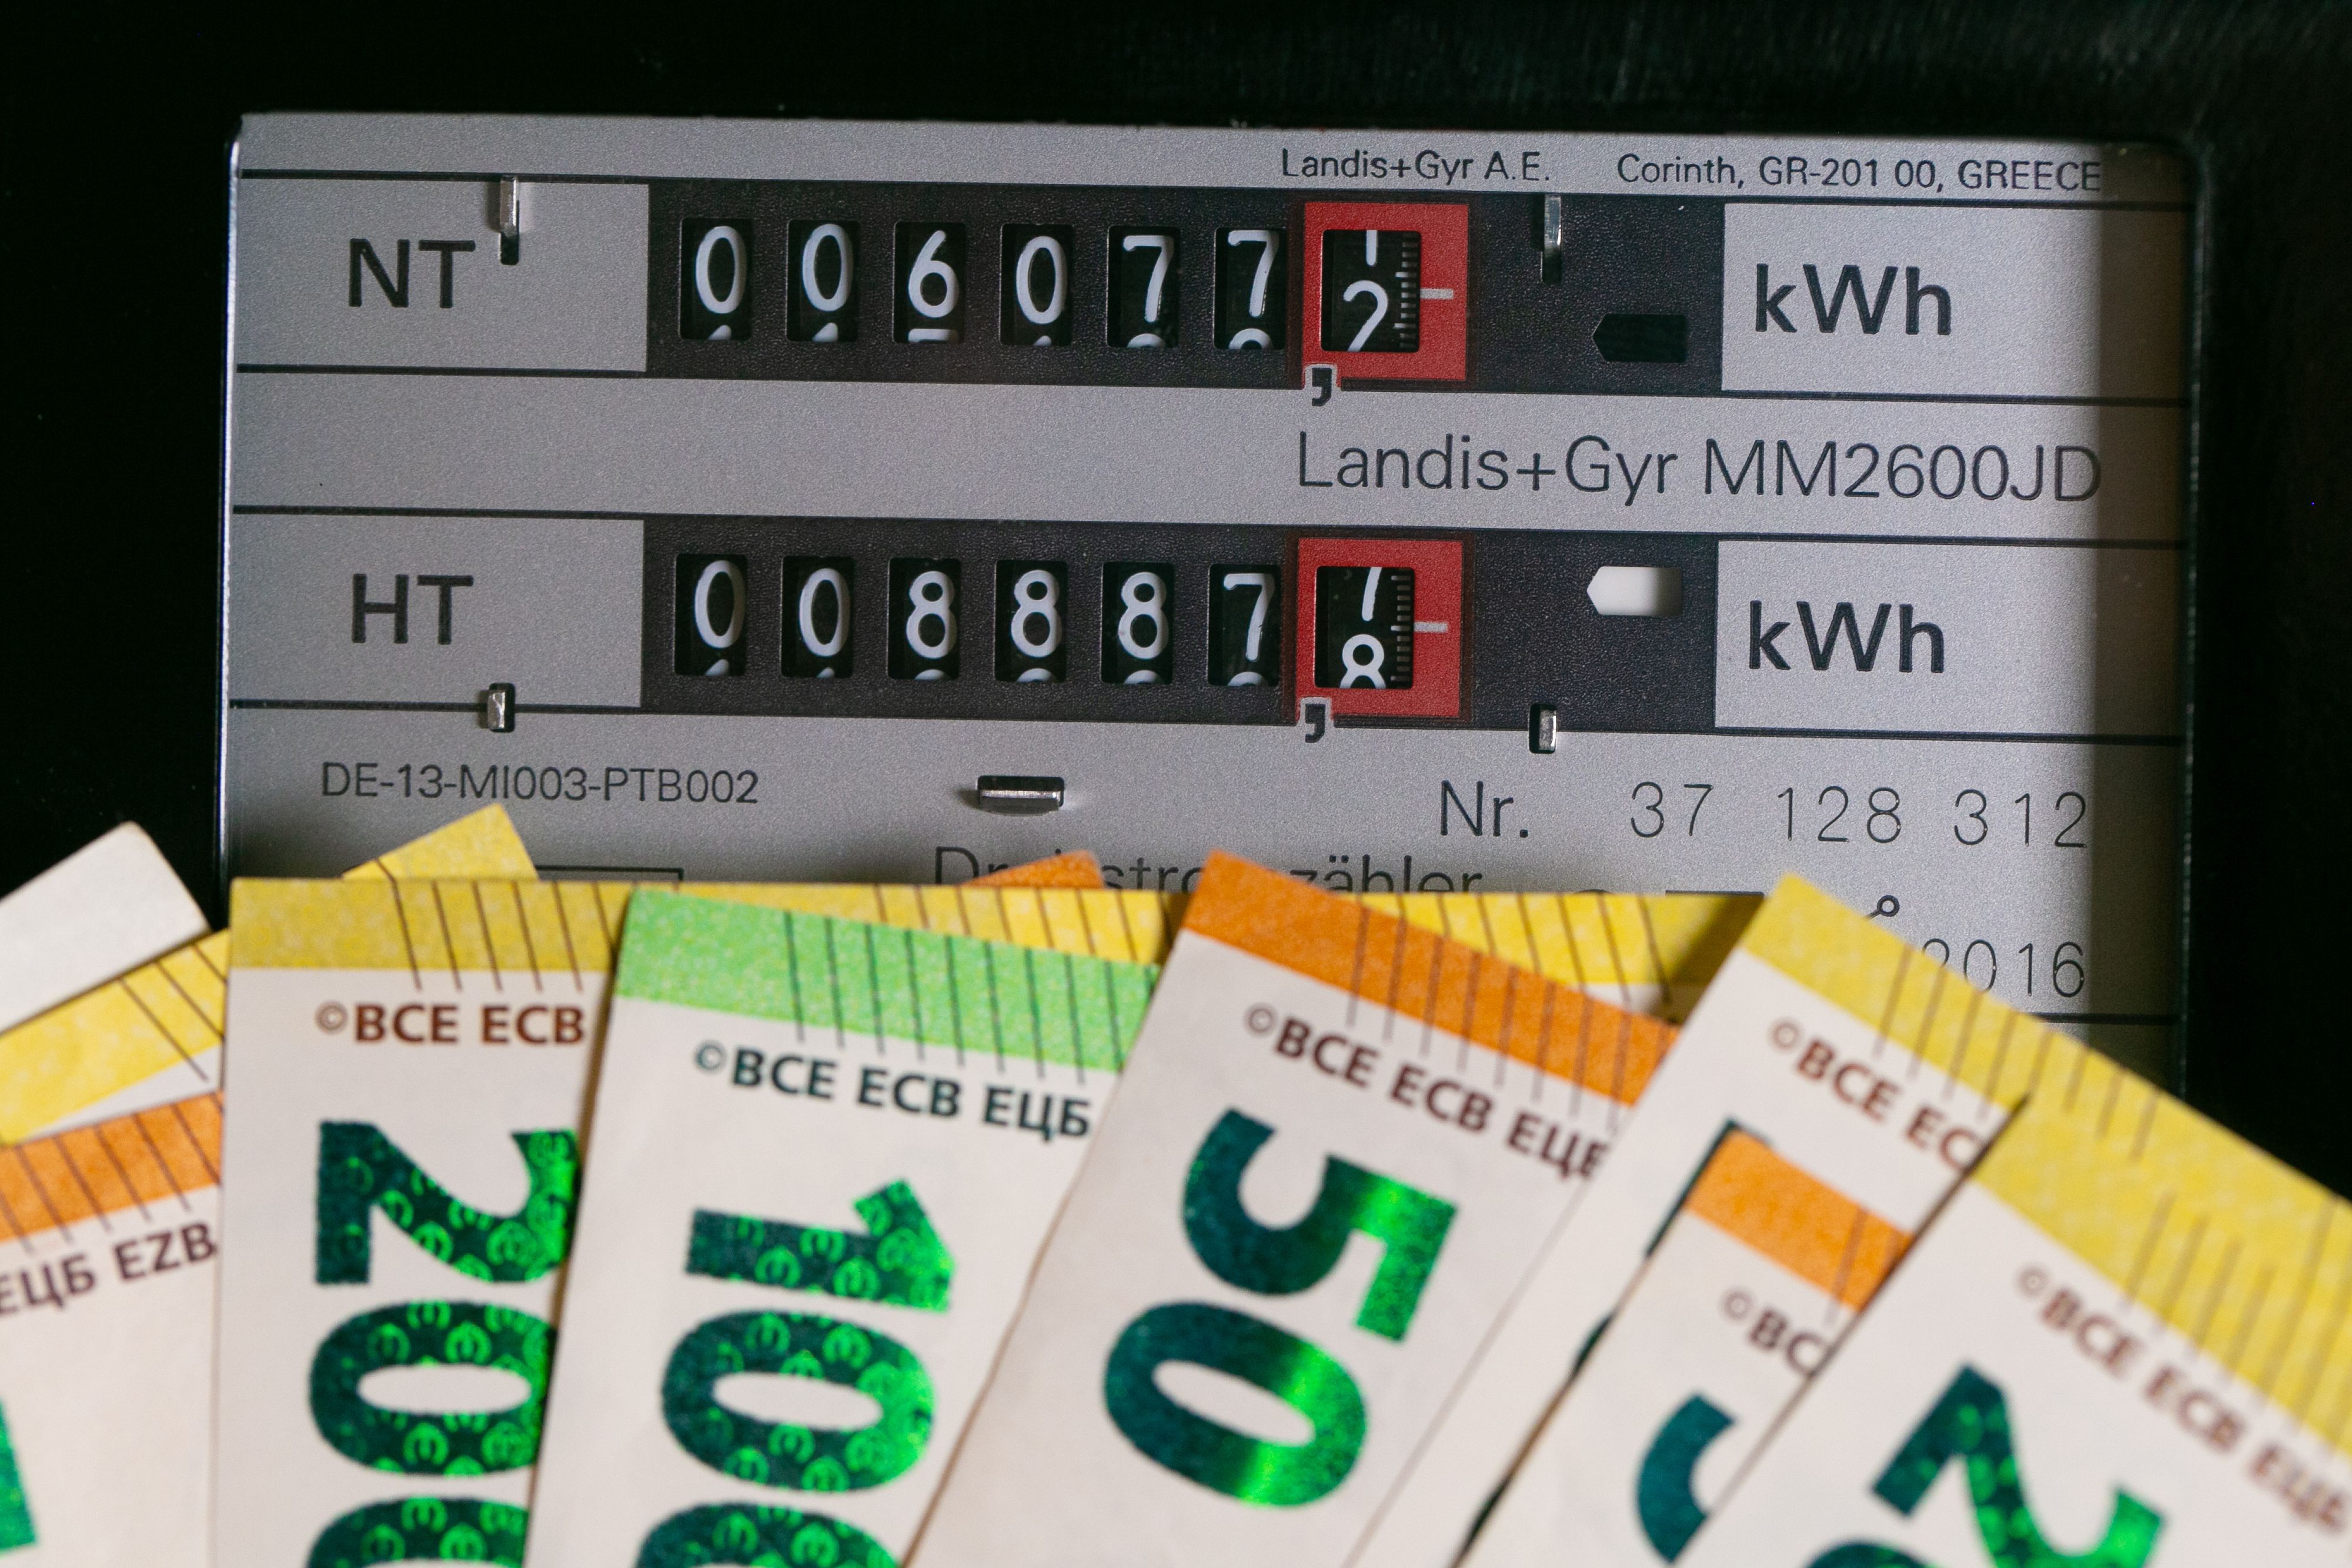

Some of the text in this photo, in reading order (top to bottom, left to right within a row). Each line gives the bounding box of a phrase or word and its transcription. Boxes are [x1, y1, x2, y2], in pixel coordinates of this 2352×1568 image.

[1282, 148, 2103, 193] Landis+Gyr A.E. Corinth, GR-201 00, GREECE
[349, 238, 476, 309] NT
[1755, 263, 1952, 336] kWh
[1298, 430, 2103, 507] Landis+Gyr MM2600JD
[352, 573, 475, 645] HT
[1749, 600, 1945, 674] kWh
[322, 761, 759, 804] DE-13-MI003-PTB002
[1440, 780, 2088, 848] Nr. 37 128 312
[482, 1004, 584, 1047] ECB
[856, 1066, 963, 1119] ECB
[1387, 1063, 1495, 1135] ECB
[113, 1221, 220, 1282] EZB
[1102, 1106, 1459, 1508] 50
